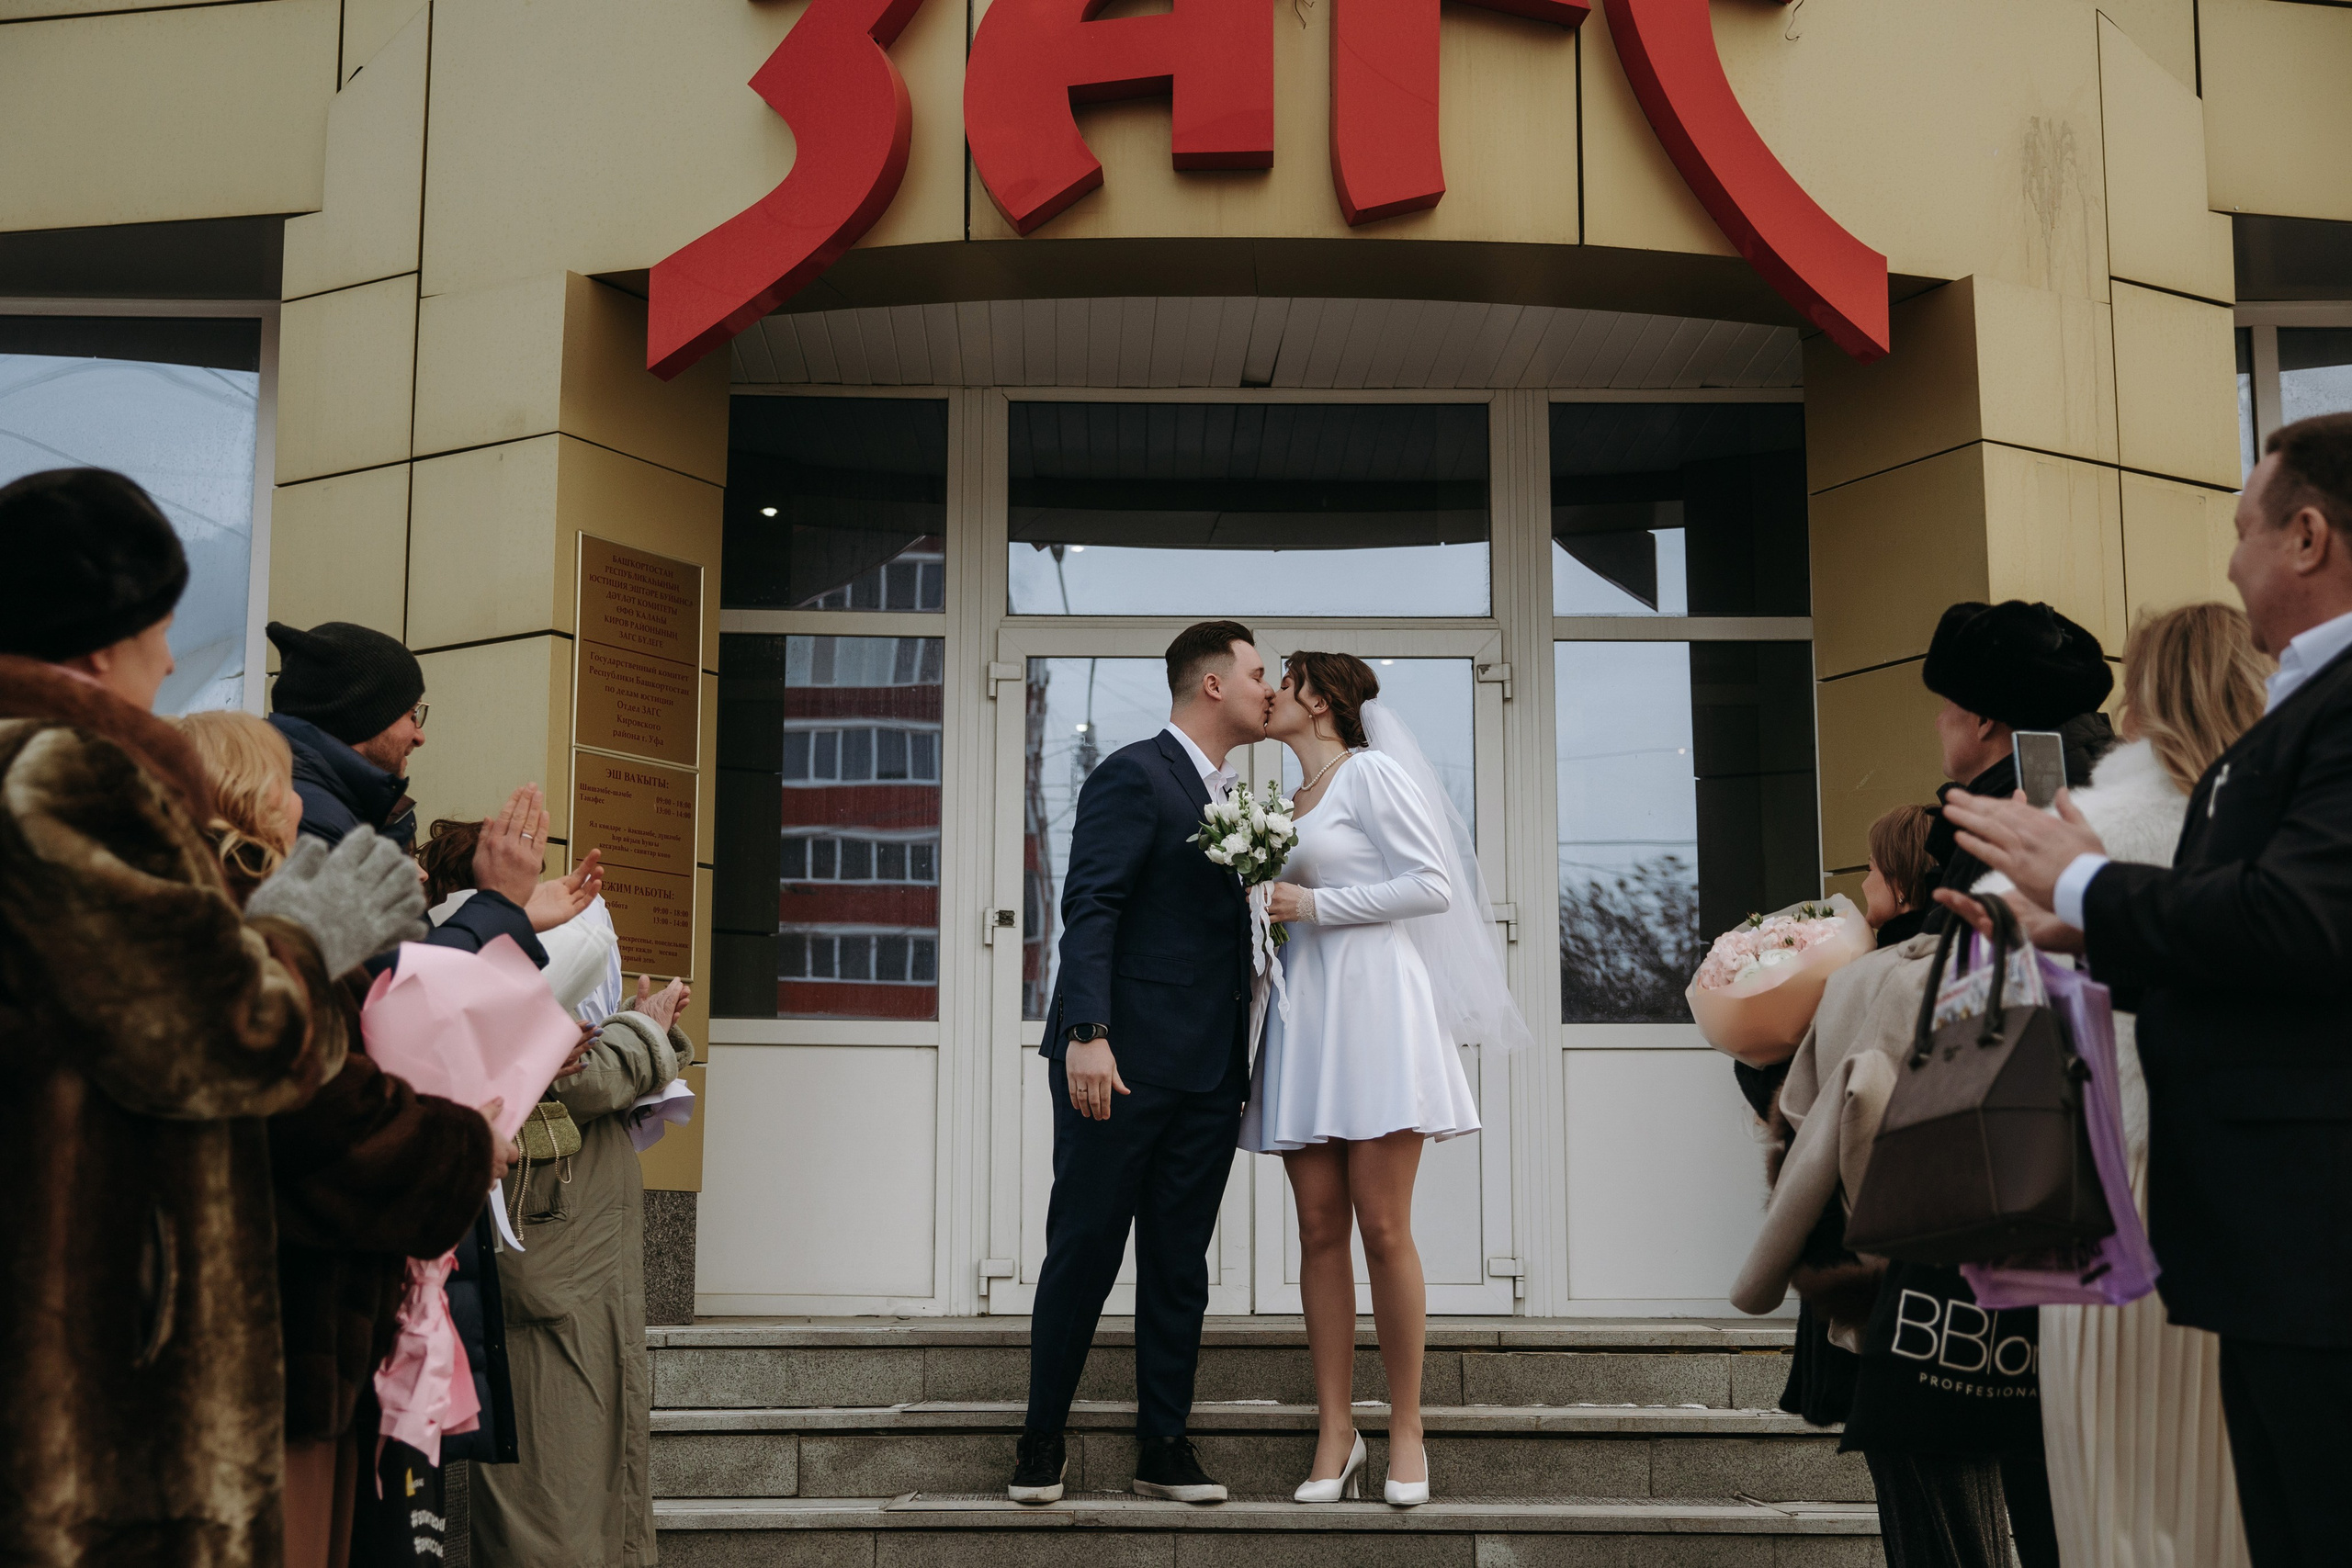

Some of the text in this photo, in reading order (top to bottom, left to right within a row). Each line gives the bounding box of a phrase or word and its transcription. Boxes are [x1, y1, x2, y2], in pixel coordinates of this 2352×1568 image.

[590, 574, 627, 589] ЮСТИЦИЯ
[629, 584, 658, 597] ЭШТӘРЕ
[616, 605, 634, 615] ӨФӨ
[638, 599, 677, 615] КОМИТЕТЫ
[605, 615, 628, 626] КИРОВ
[619, 631, 636, 642] ЗАГС
[590, 651, 689, 682] Государственный комитет
[590, 666, 689, 695] Республики Башкортостан
[605, 684, 673, 705] по делам юстиции
[617, 700, 661, 716] Отдел ЗАГС
[617, 715, 661, 731] Кировского
[613, 729, 639, 740] района
[650, 736, 663, 747] Уфа
[606, 769, 621, 780] ЭШ
[656, 796, 671, 806] 09:00
[656, 807, 671, 816] 13:00
[676, 810, 691, 819] 14:00
[602, 880, 674, 899] ЕЖИМ РАБОТЫ:
[653, 907, 669, 915] 09:00
[674, 909, 688, 918] 18:00
[653, 917, 668, 926] 13:00
[673, 919, 688, 928] 14:00
